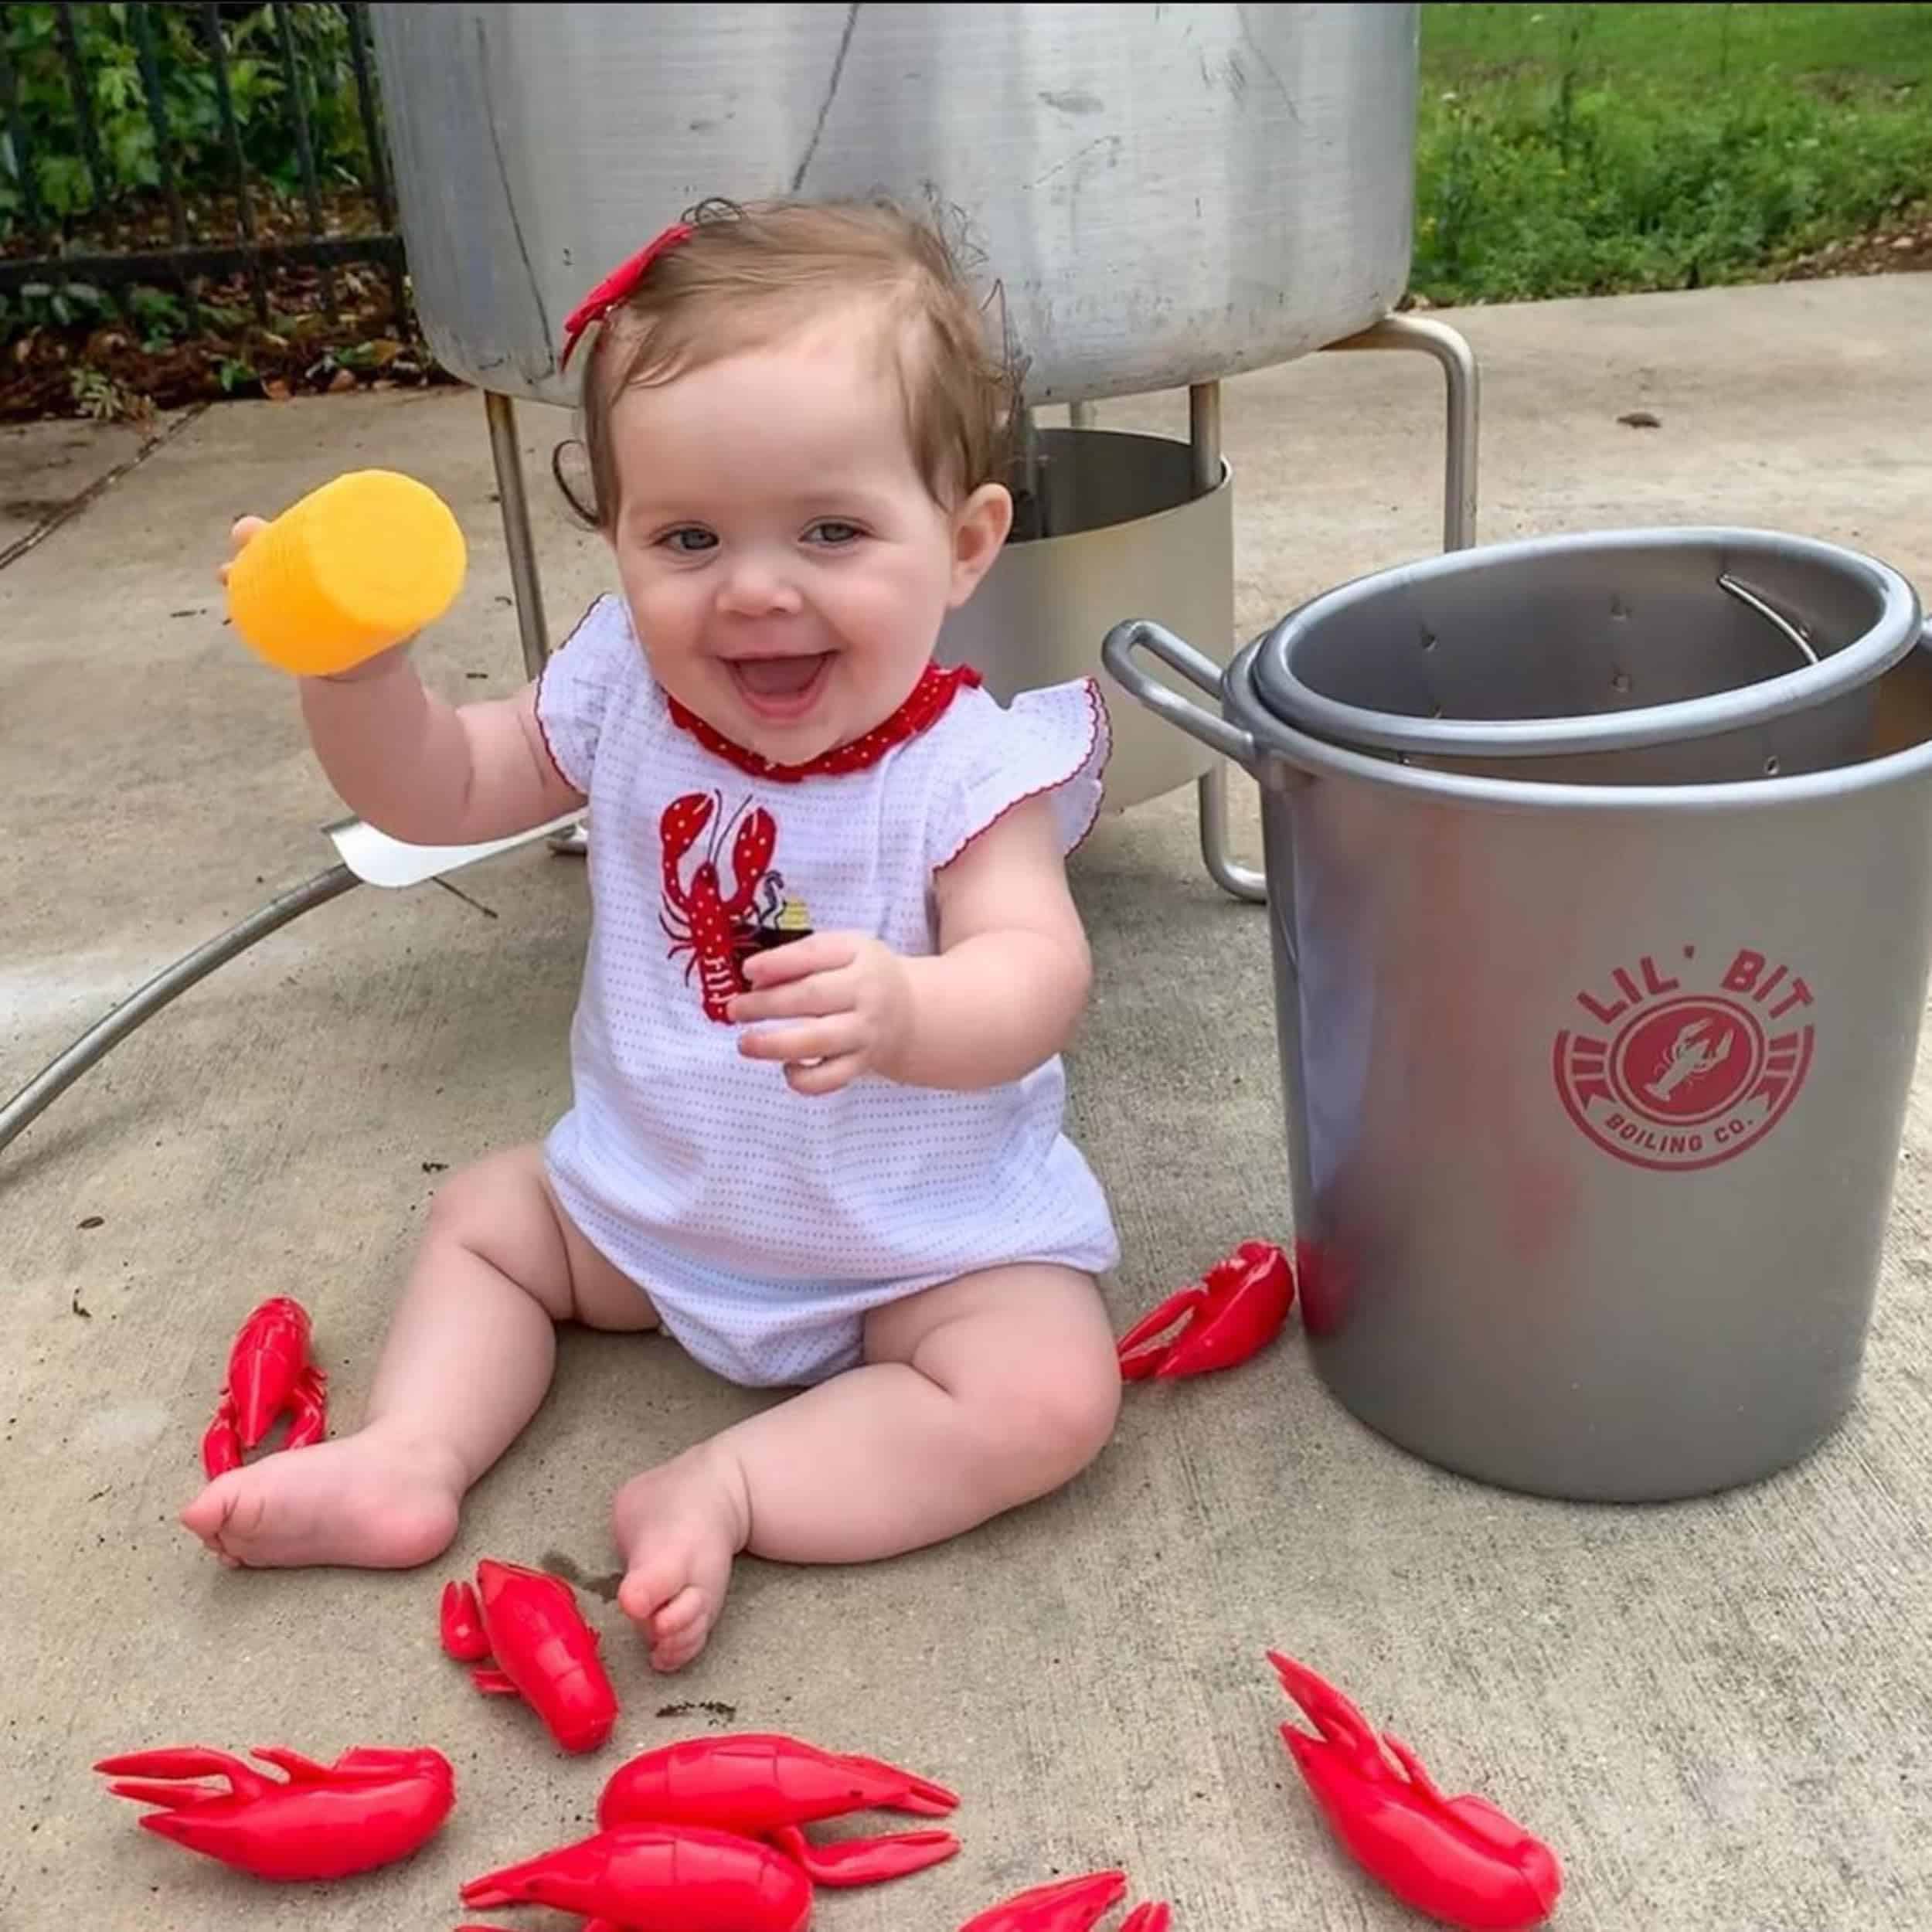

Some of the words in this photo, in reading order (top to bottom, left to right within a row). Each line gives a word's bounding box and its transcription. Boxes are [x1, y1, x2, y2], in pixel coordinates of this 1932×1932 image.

[1721, 948, 1815, 1019] BIT
[1605, 1113, 1702, 1154] BOILING
[1714, 1117, 1754, 1145] CO.
